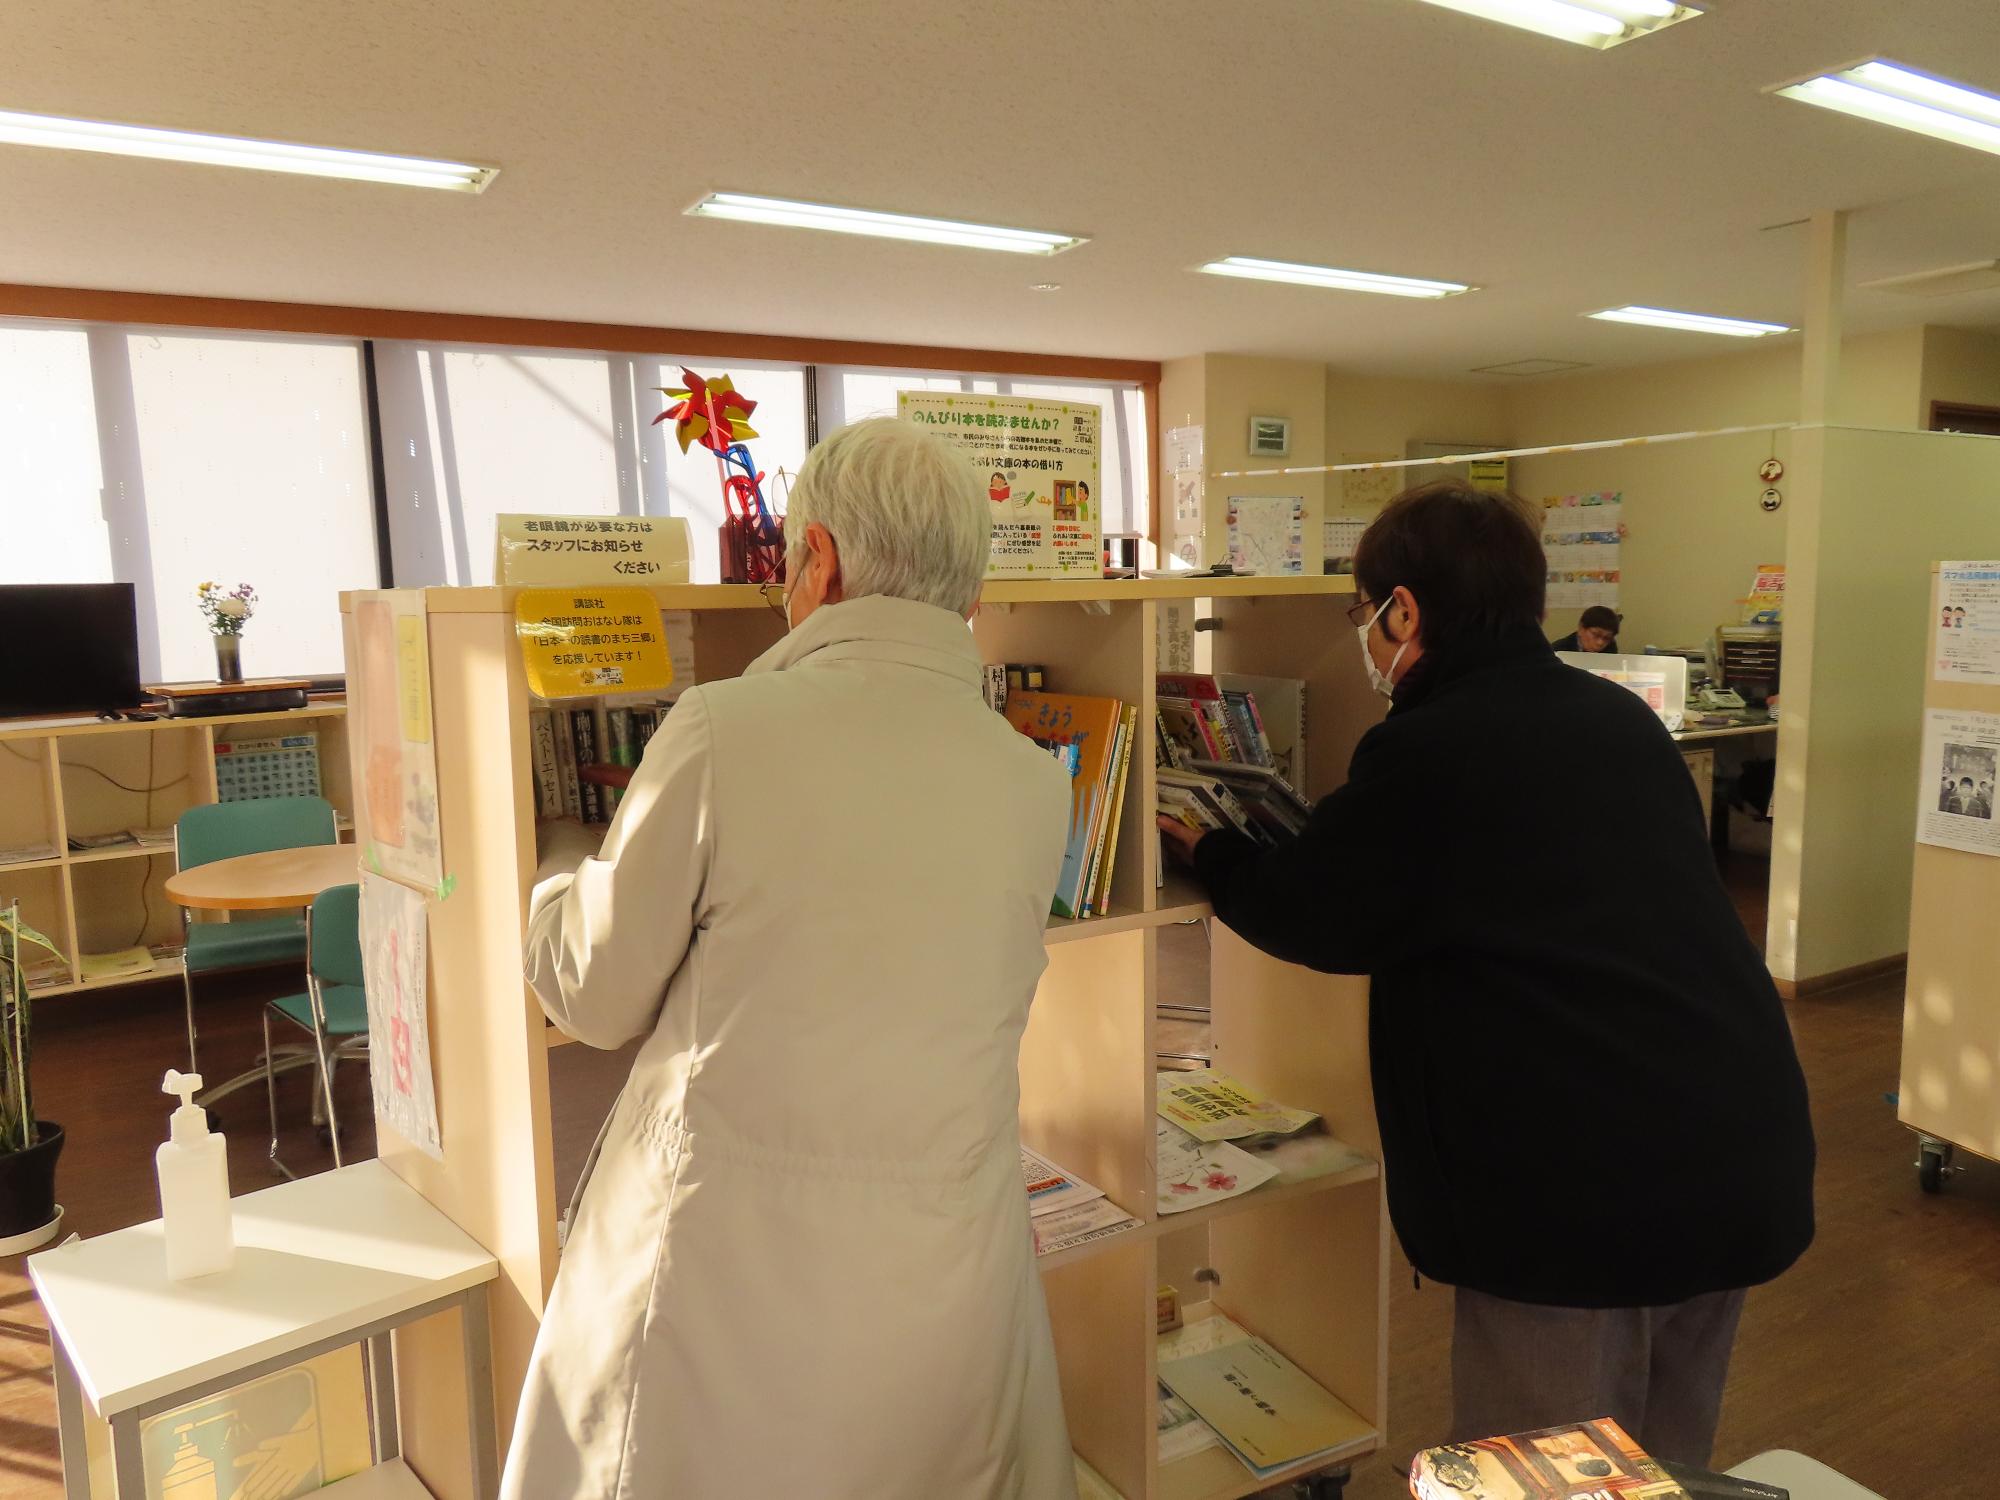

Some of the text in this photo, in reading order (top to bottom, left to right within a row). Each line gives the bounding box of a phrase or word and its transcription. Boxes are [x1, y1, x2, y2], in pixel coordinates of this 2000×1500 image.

[523, 520, 653, 533] 老眼鏡が必要な方は
[527, 539, 643, 552] スタッフにお知らせ
[613, 561, 660, 574] ください
[574, 598, 605, 609] 講談社
[552, 651, 643, 665] を応援しています！
